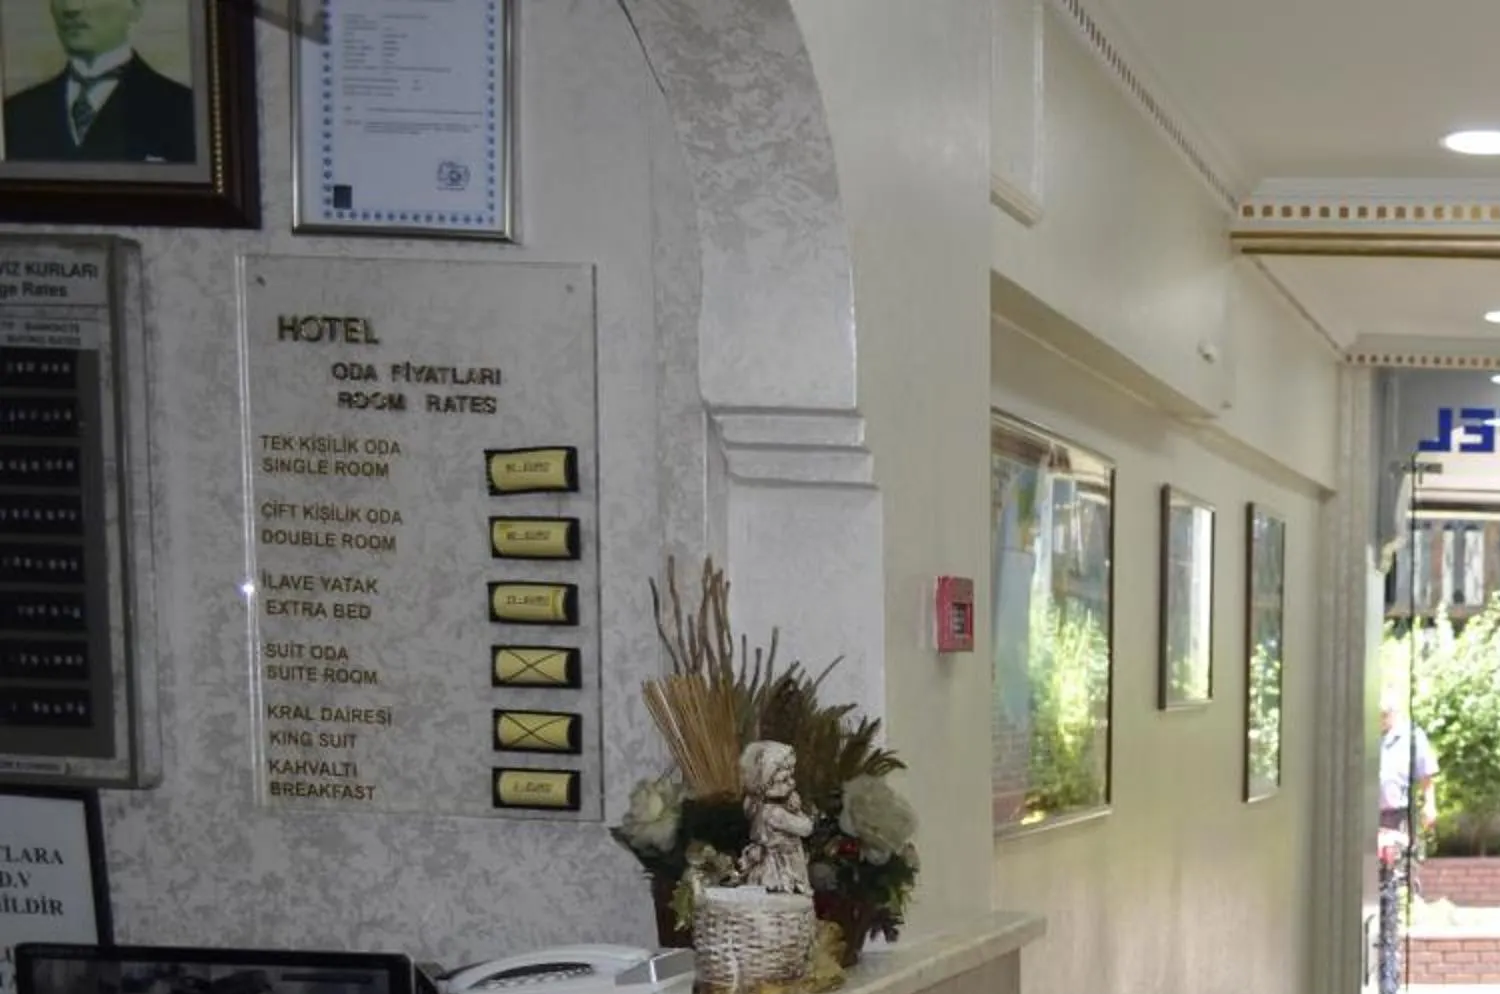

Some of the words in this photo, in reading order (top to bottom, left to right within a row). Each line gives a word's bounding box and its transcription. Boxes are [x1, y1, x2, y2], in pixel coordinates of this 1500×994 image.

[25, 261, 98, 279] KURLARI
[22, 281, 68, 297] Rates
[277, 315, 380, 344] HOTEL
[331, 362, 377, 381] ODA
[392, 361, 501, 385] FİYATLARI
[337, 391, 407, 411] ROOM
[426, 394, 497, 414] RATES
[260, 435, 293, 451] TEK
[364, 439, 401, 454] ODA
[262, 458, 328, 475] SINGLE
[335, 461, 389, 477] ROOM
[367, 508, 403, 525] ODA
[261, 529, 336, 547] DOUBLE
[342, 533, 397, 551] ROOM
[320, 576, 378, 593] YATAK
[266, 600, 328, 618] EXTRA
[333, 603, 371, 620] BED
[310, 645, 349, 660] ODA
[266, 665, 317, 681] SUITE
[323, 668, 378, 684] ROOM
[267, 705, 314, 721] KRAL
[269, 731, 313, 747] KING
[269, 759, 358, 777] KAHVALTI
[269, 782, 376, 800] BREAKFAST
